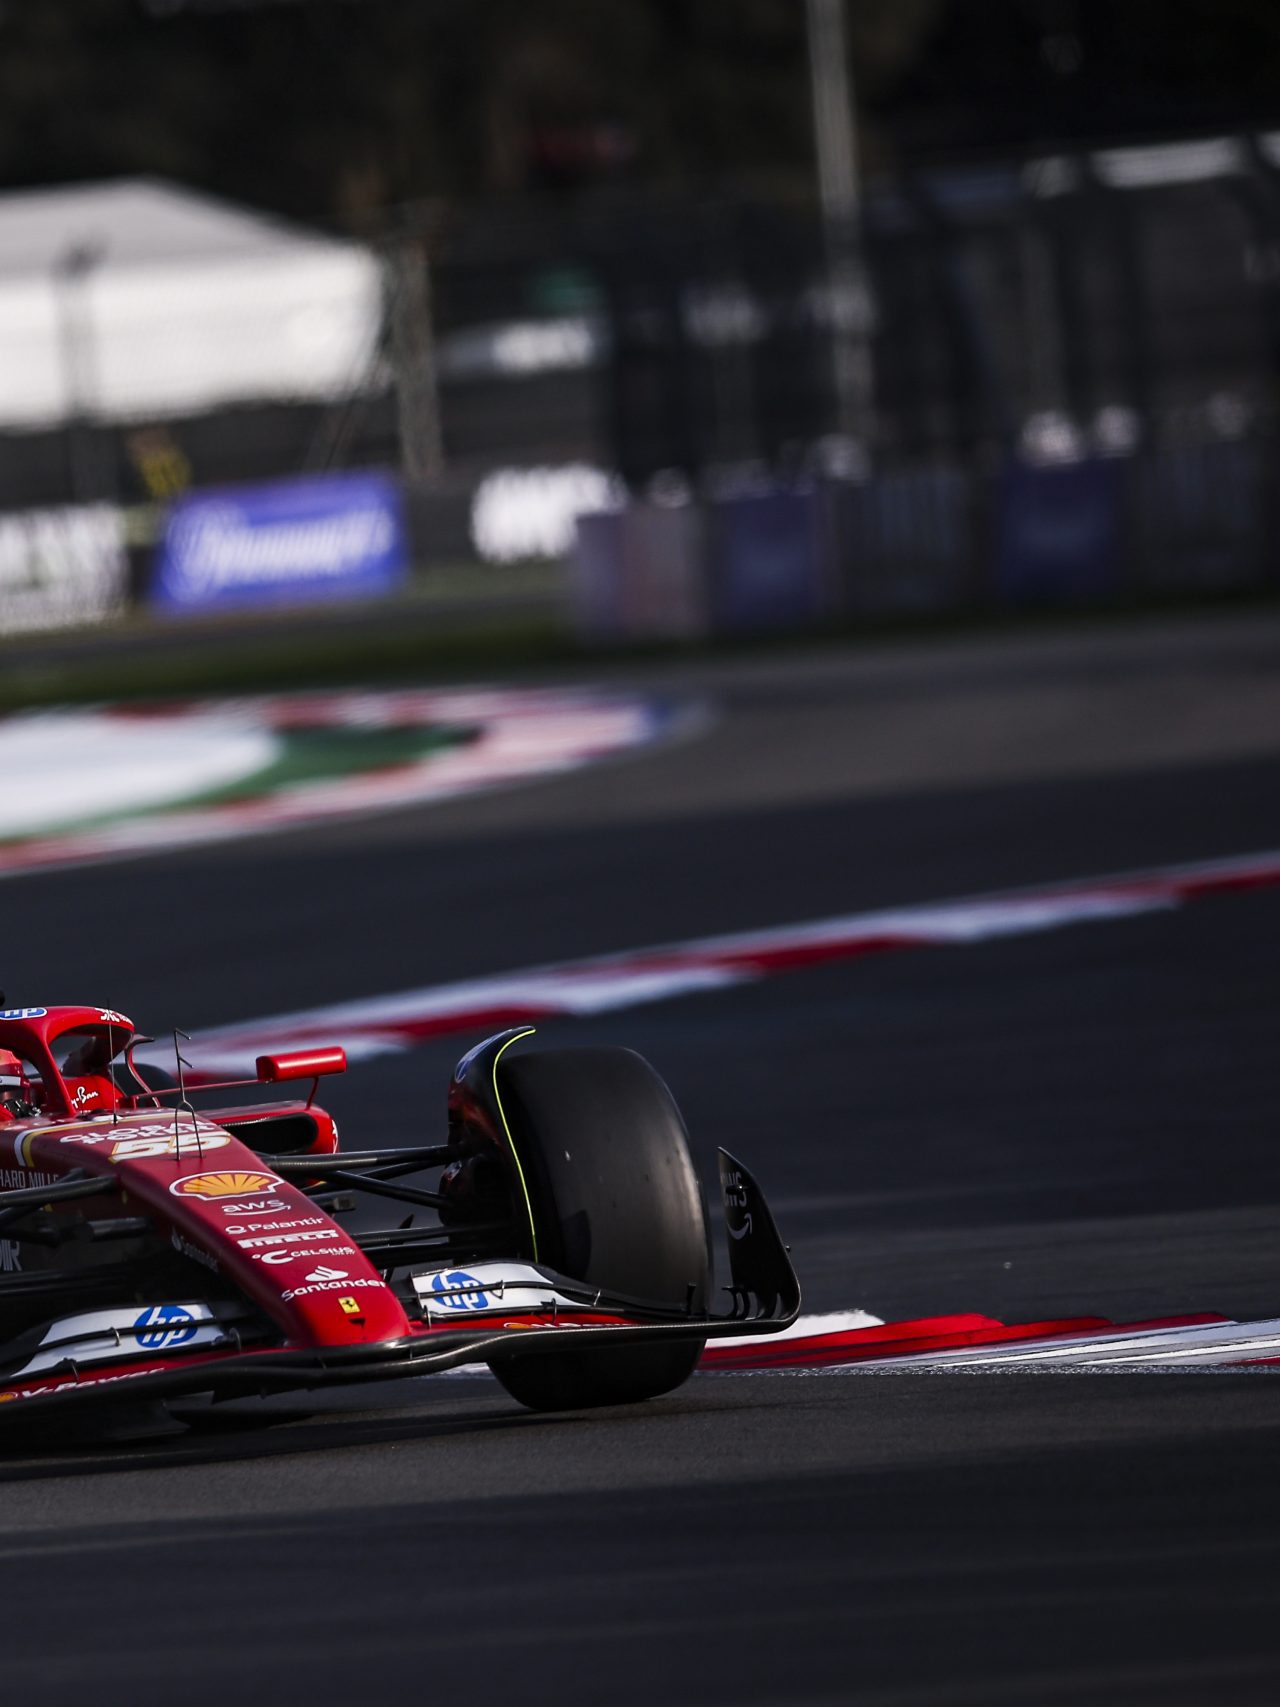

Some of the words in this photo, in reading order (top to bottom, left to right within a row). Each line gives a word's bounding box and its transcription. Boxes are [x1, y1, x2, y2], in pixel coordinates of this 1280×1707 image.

[108, 1131, 231, 1165] 55
[222, 1199, 286, 1214] aws
[248, 1217, 324, 1232] Palantir
[237, 1229, 339, 1249] PIRELLI
[291, 1246, 354, 1258] CELSIUS
[281, 1279, 387, 1302] Santander
[439, 1273, 480, 1310] hp
[142, 1306, 191, 1348] hp
[22, 1367, 166, 1399] V-Power
